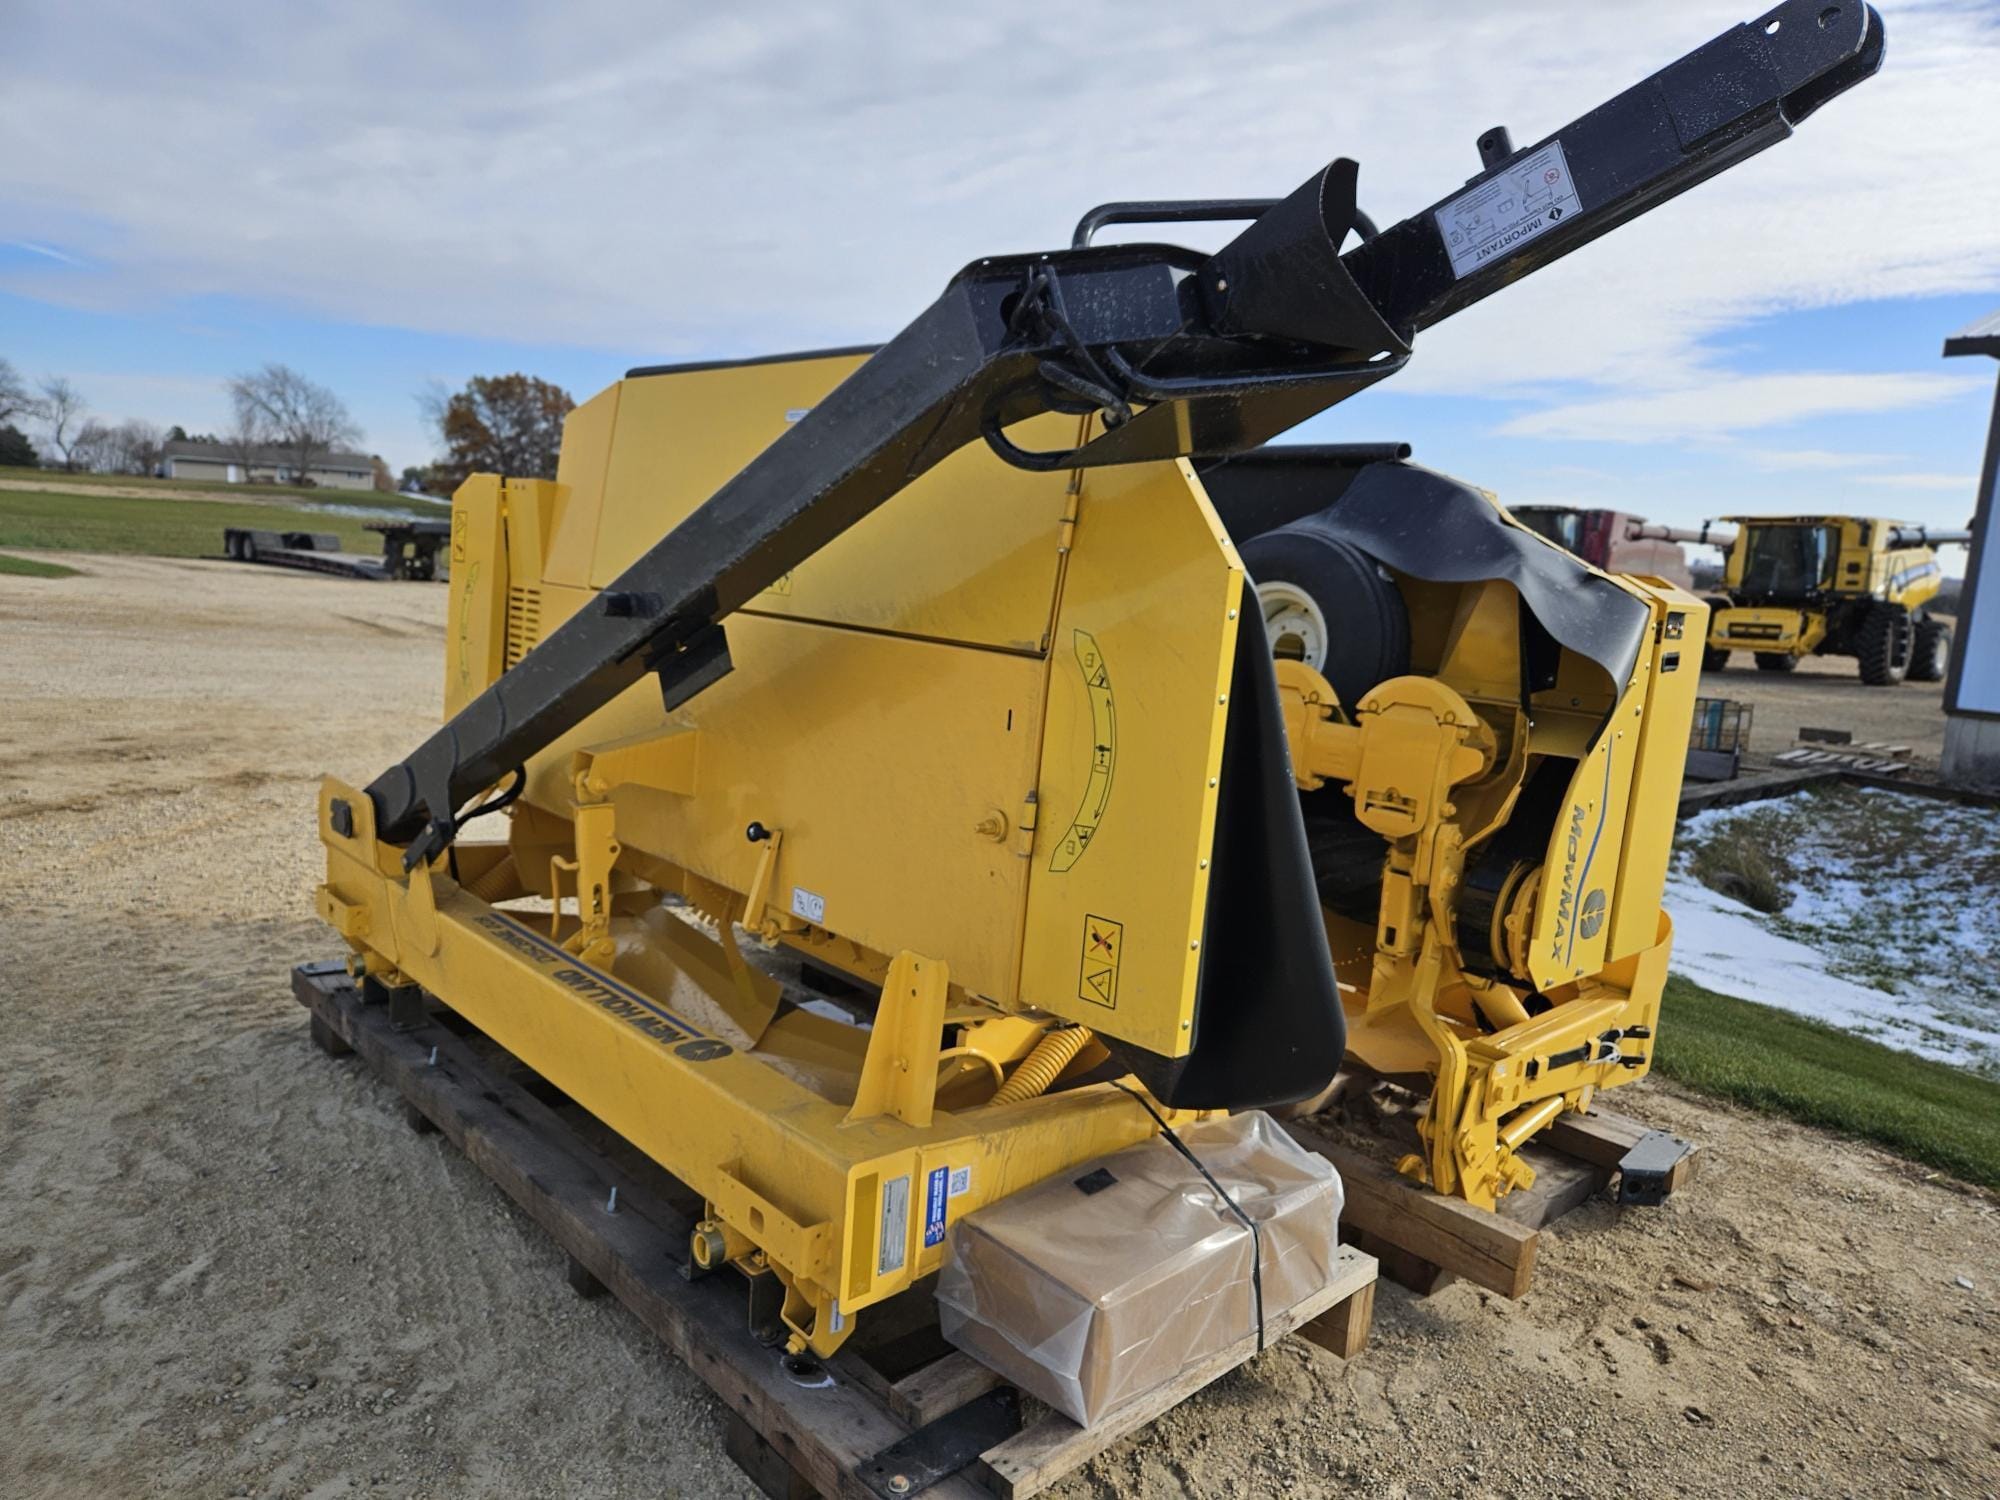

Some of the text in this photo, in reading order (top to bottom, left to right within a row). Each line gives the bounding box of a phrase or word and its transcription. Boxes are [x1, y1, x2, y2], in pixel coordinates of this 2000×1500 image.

[1475, 217, 1542, 261] IMPORTANT
[552, 968, 644, 1021] HOLLAND
[627, 1014, 688, 1045] NEW
